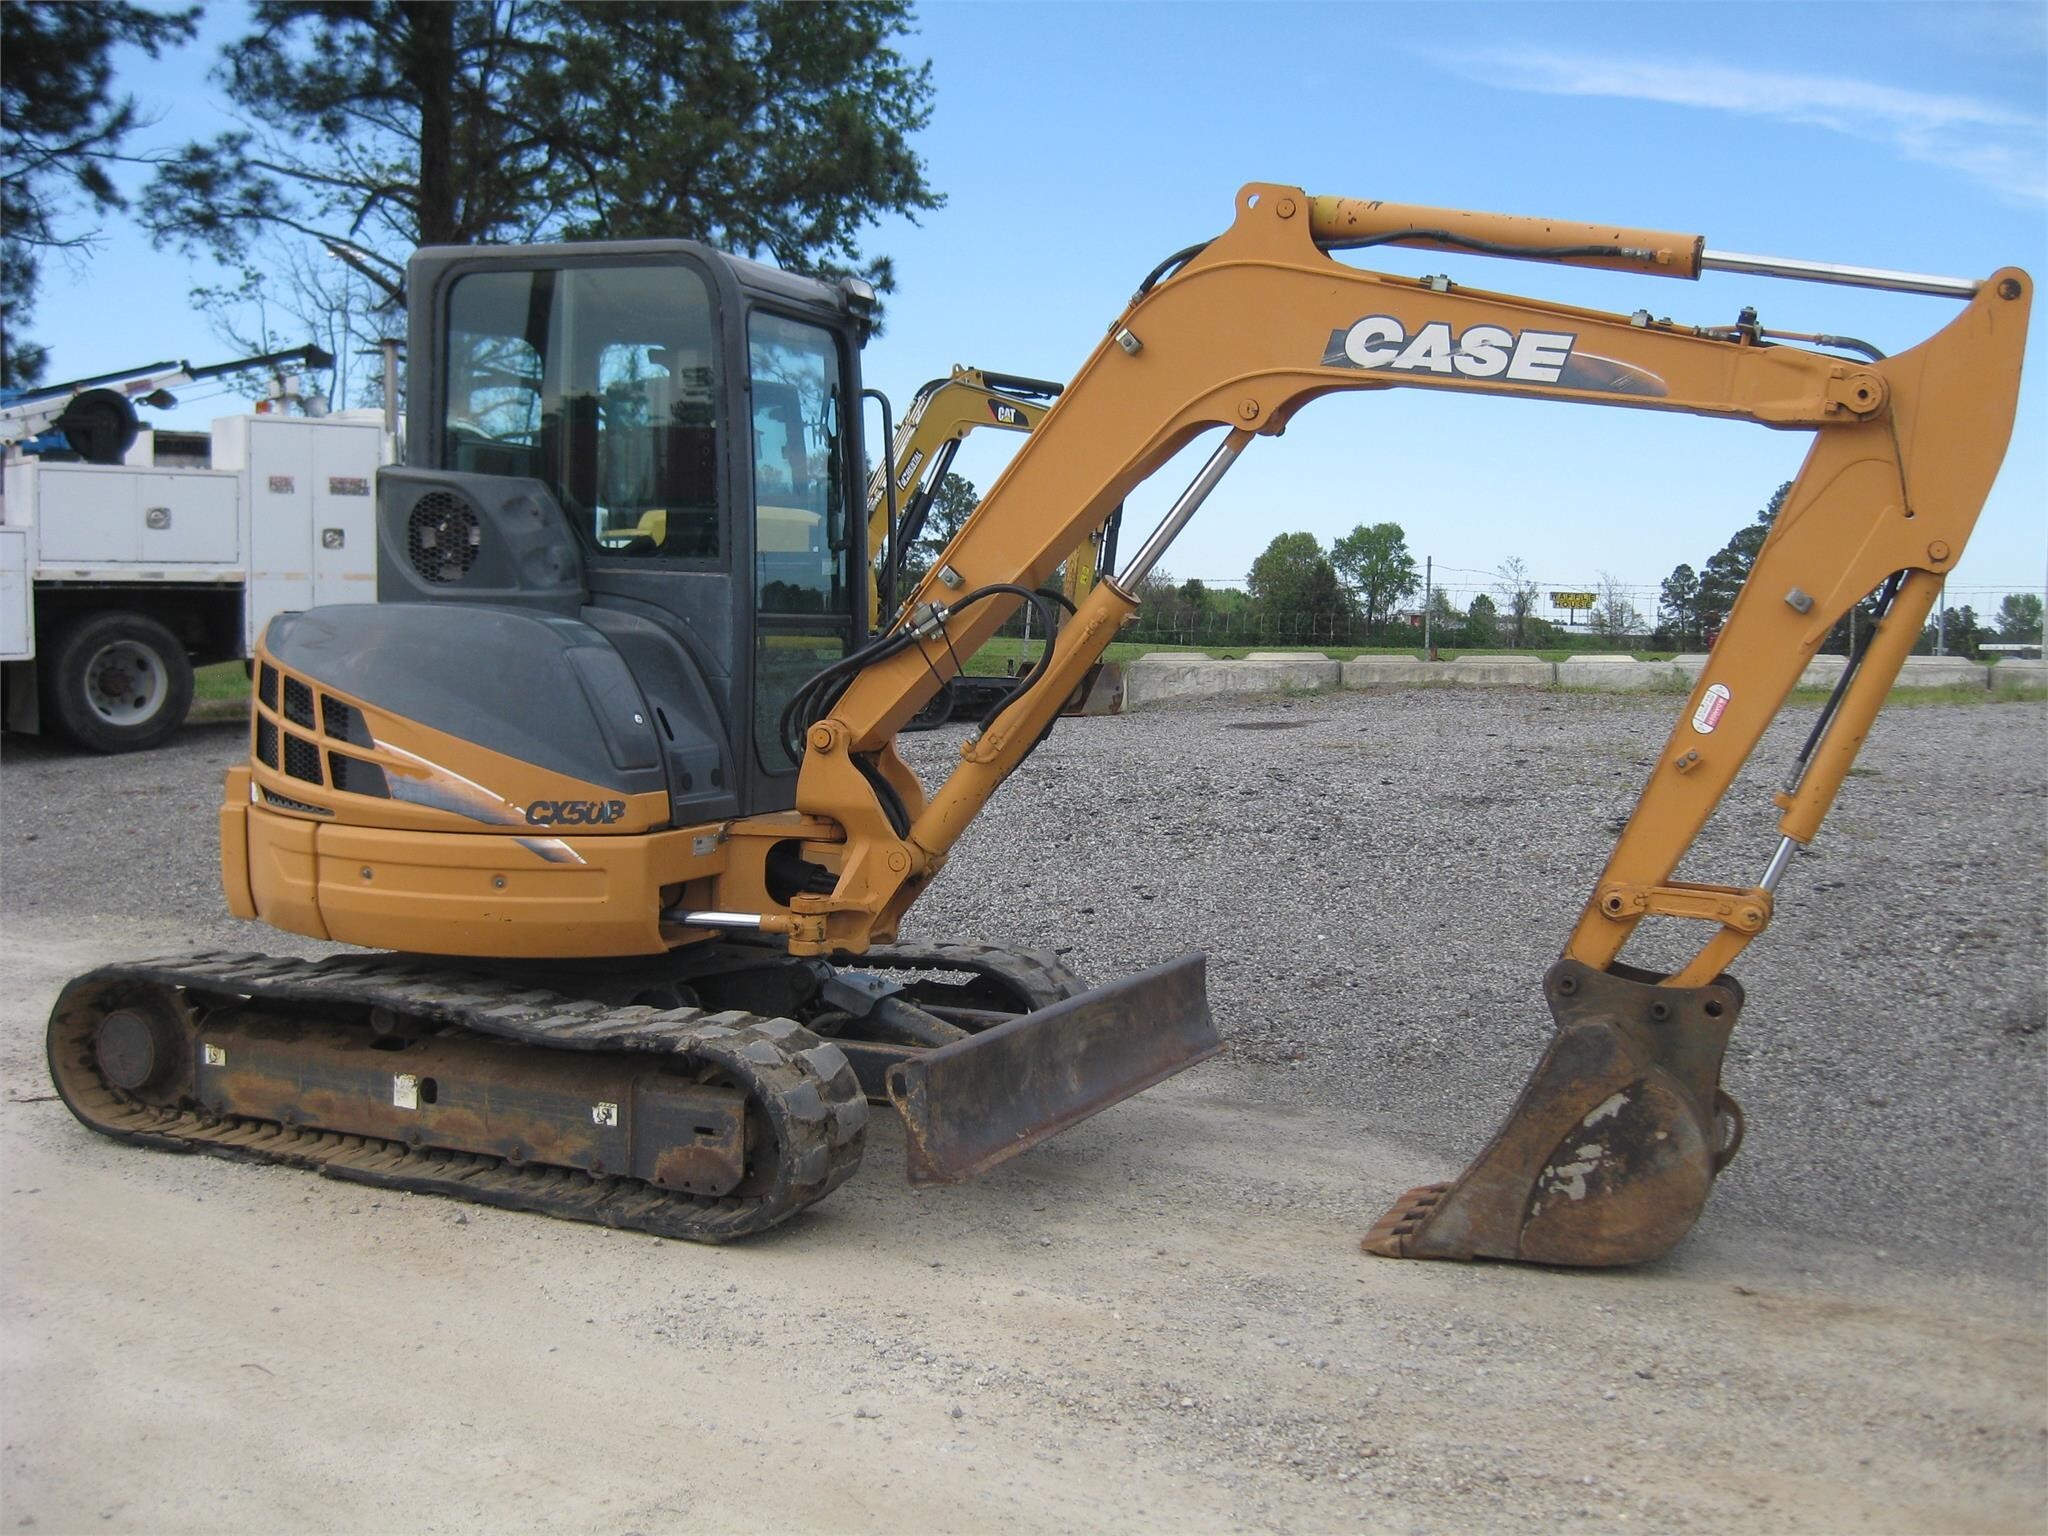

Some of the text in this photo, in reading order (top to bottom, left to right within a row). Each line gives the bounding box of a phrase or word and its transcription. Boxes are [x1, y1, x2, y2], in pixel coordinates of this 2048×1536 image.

[1344, 315, 1575, 384] CASE
[998, 406, 1016, 423] CAT
[1551, 593, 1596, 601] WAFFLE
